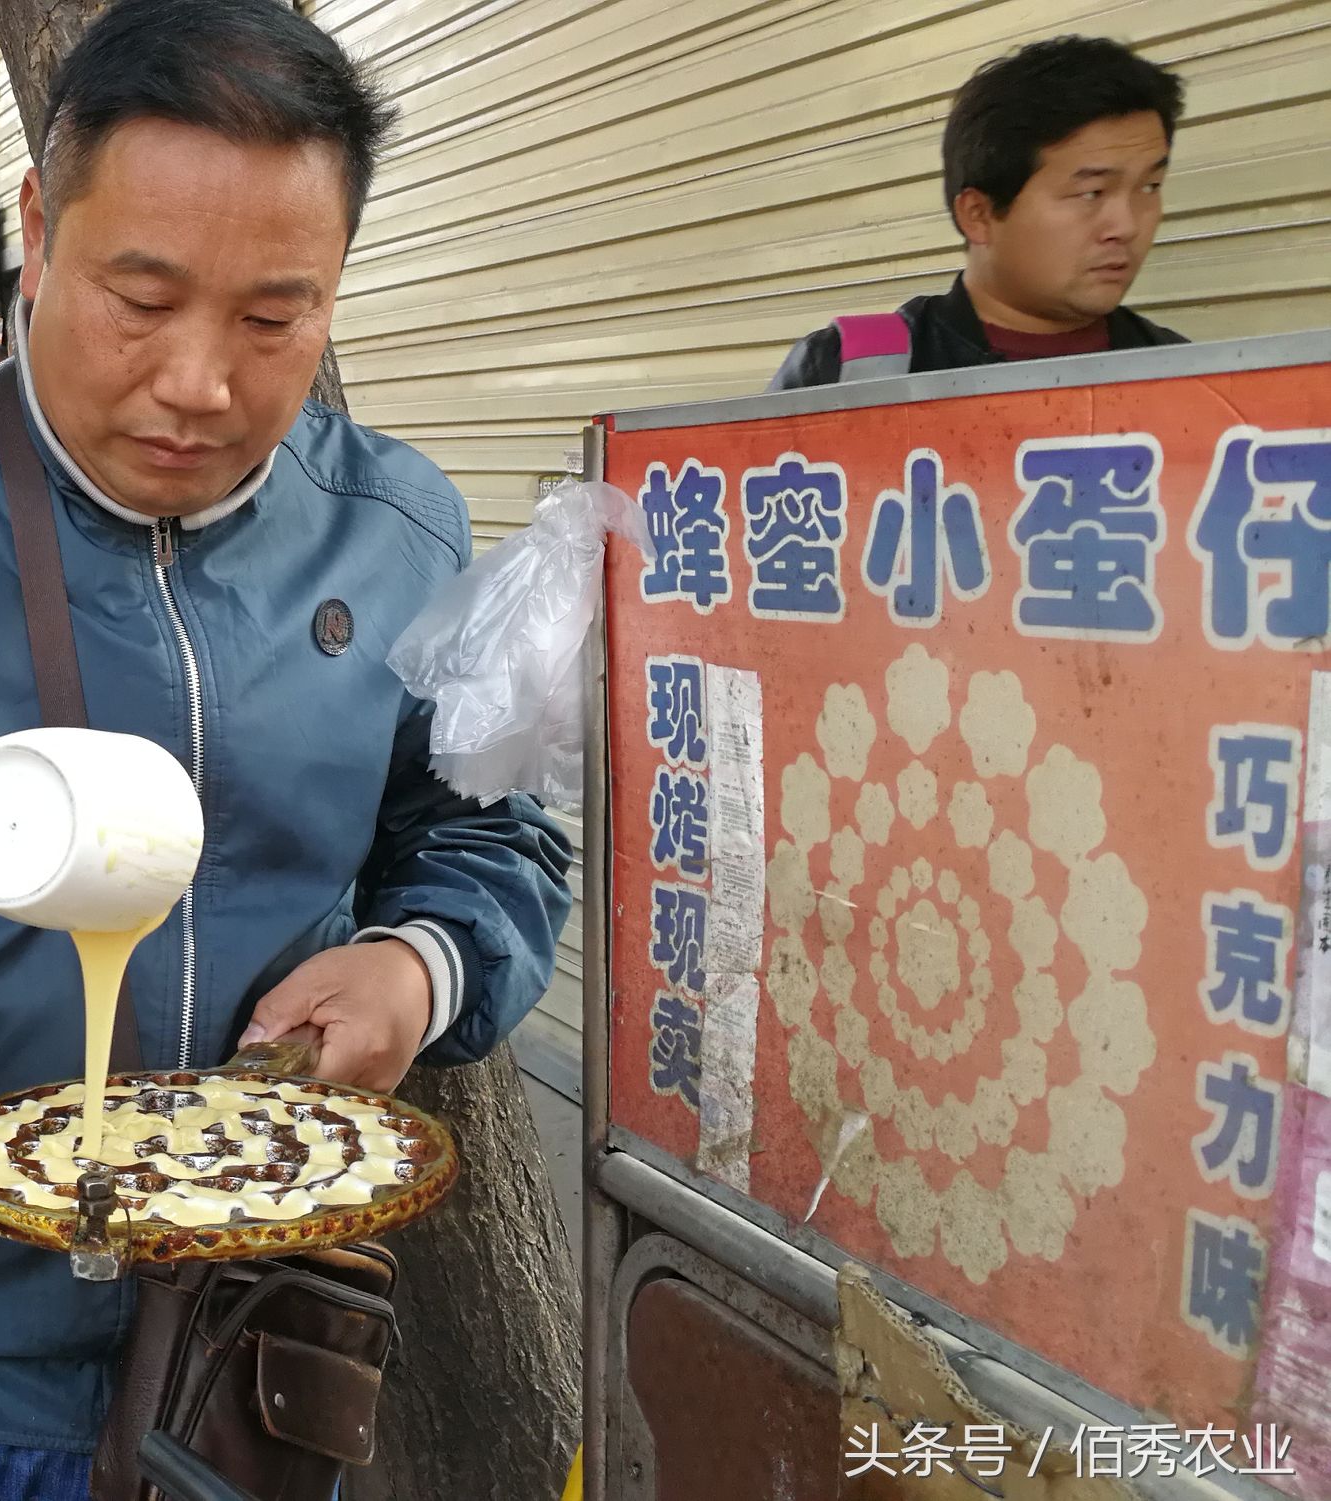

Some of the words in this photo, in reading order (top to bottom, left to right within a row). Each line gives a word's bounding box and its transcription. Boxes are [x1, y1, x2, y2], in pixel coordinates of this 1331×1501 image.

[638, 427, 1331, 652] 蜂蜜小蛋仔
[645, 653, 709, 1113] 现烤现卖
[1182, 721, 1302, 1361] 巧克力味
